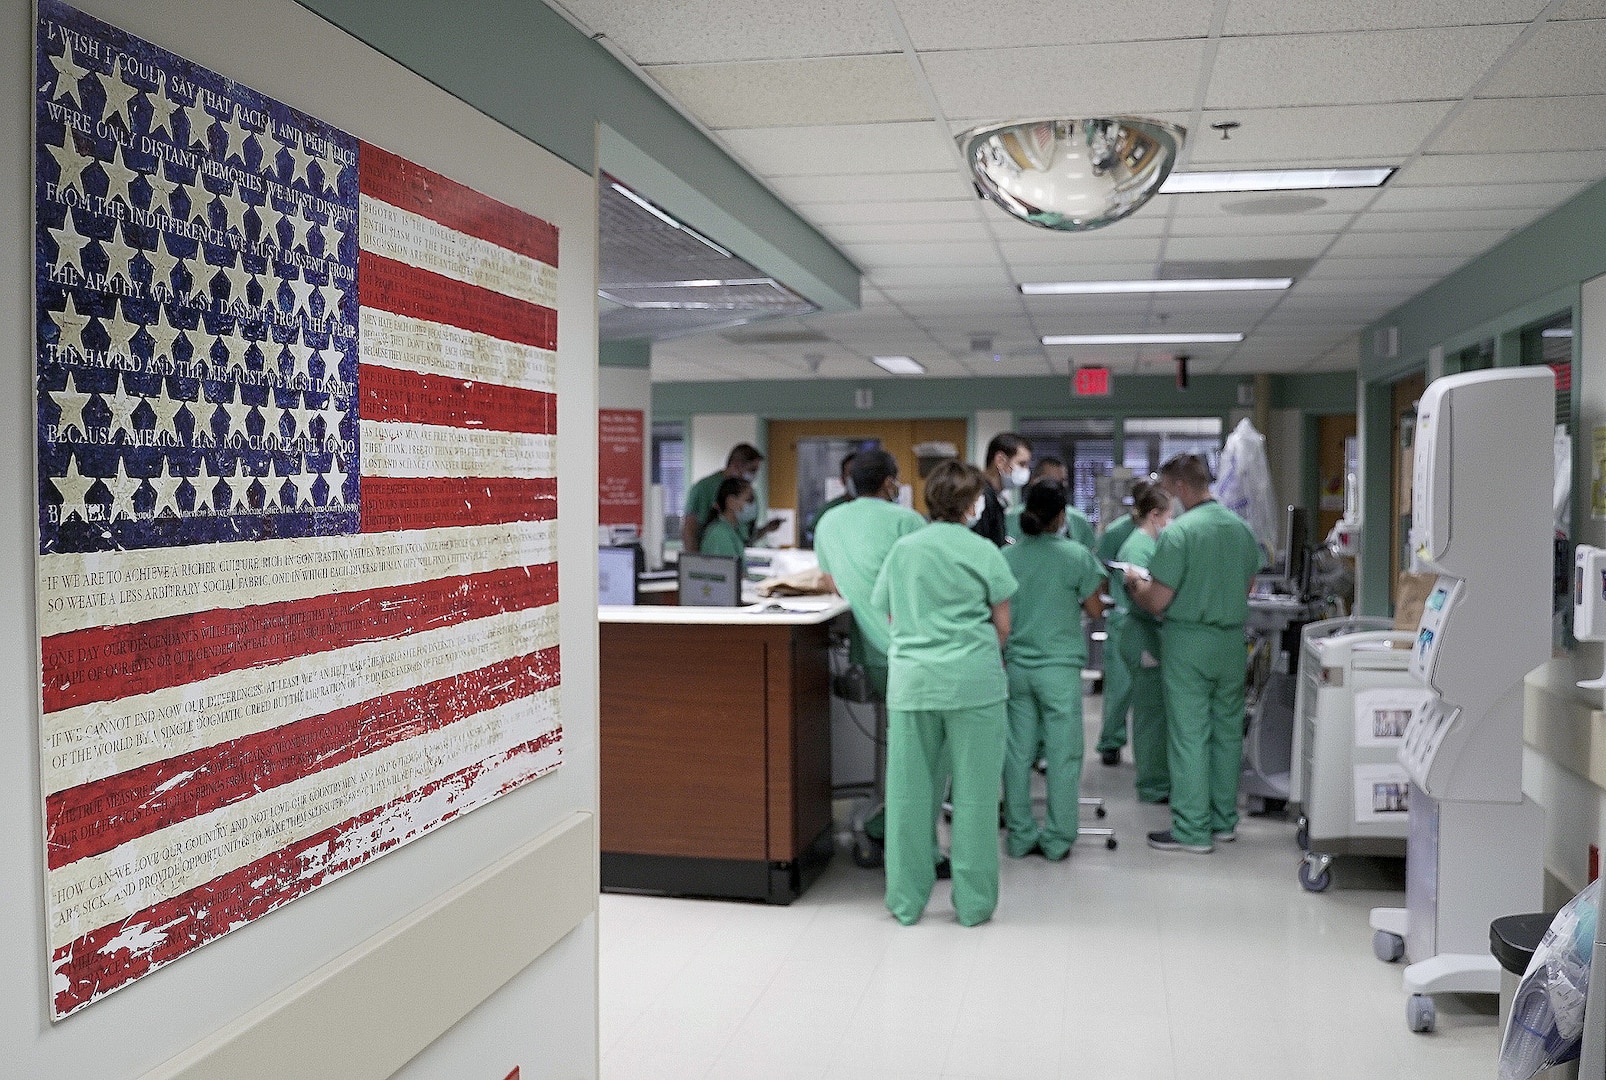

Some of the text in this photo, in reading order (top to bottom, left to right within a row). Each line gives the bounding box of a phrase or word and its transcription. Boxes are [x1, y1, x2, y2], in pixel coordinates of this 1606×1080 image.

[58, 24, 99, 61] WISH
[118, 50, 166, 88] COULD
[171, 73, 195, 100] SAY
[305, 131, 355, 167] PREJDICE
[46, 100, 91, 135] WERE
[96, 118, 136, 150] ONLY
[141, 134, 198, 171] DISTANT
[266, 179, 283, 200] WE
[287, 186, 314, 210] MUST
[316, 197, 354, 224] DISSENT
[94, 195, 125, 221] THE
[130, 205, 226, 247] INDIFFERENCE.
[250, 238, 279, 261] MUST
[284, 248, 324, 273] DISSENT
[45, 261, 78, 287] THE
[83, 269, 144, 299] APATHY.
[82, 348, 142, 372] HATRED
[178, 360, 202, 379] THE
[61, 573, 79, 588] WE
[82, 571, 104, 586] ARE
[106, 569, 121, 584] TO
[181, 561, 215, 576] RICHER
[48, 597, 63, 613] SO
[67, 592, 106, 610] WEAVE
[108, 591, 116, 605] A
[119, 588, 142, 604] LESS
[134, 709, 155, 726] END
[158, 702, 181, 720] NOW
[184, 697, 203, 713] OUR
[52, 752, 67, 769] OF
[70, 746, 91, 764] THE
[136, 731, 149, 746] BY
[245, 700, 270, 717] CREED
[162, 842, 182, 861] OUR
[230, 816, 247, 834] AND
[250, 808, 267, 826] NOT
[138, 862, 179, 892] PROVIDE
